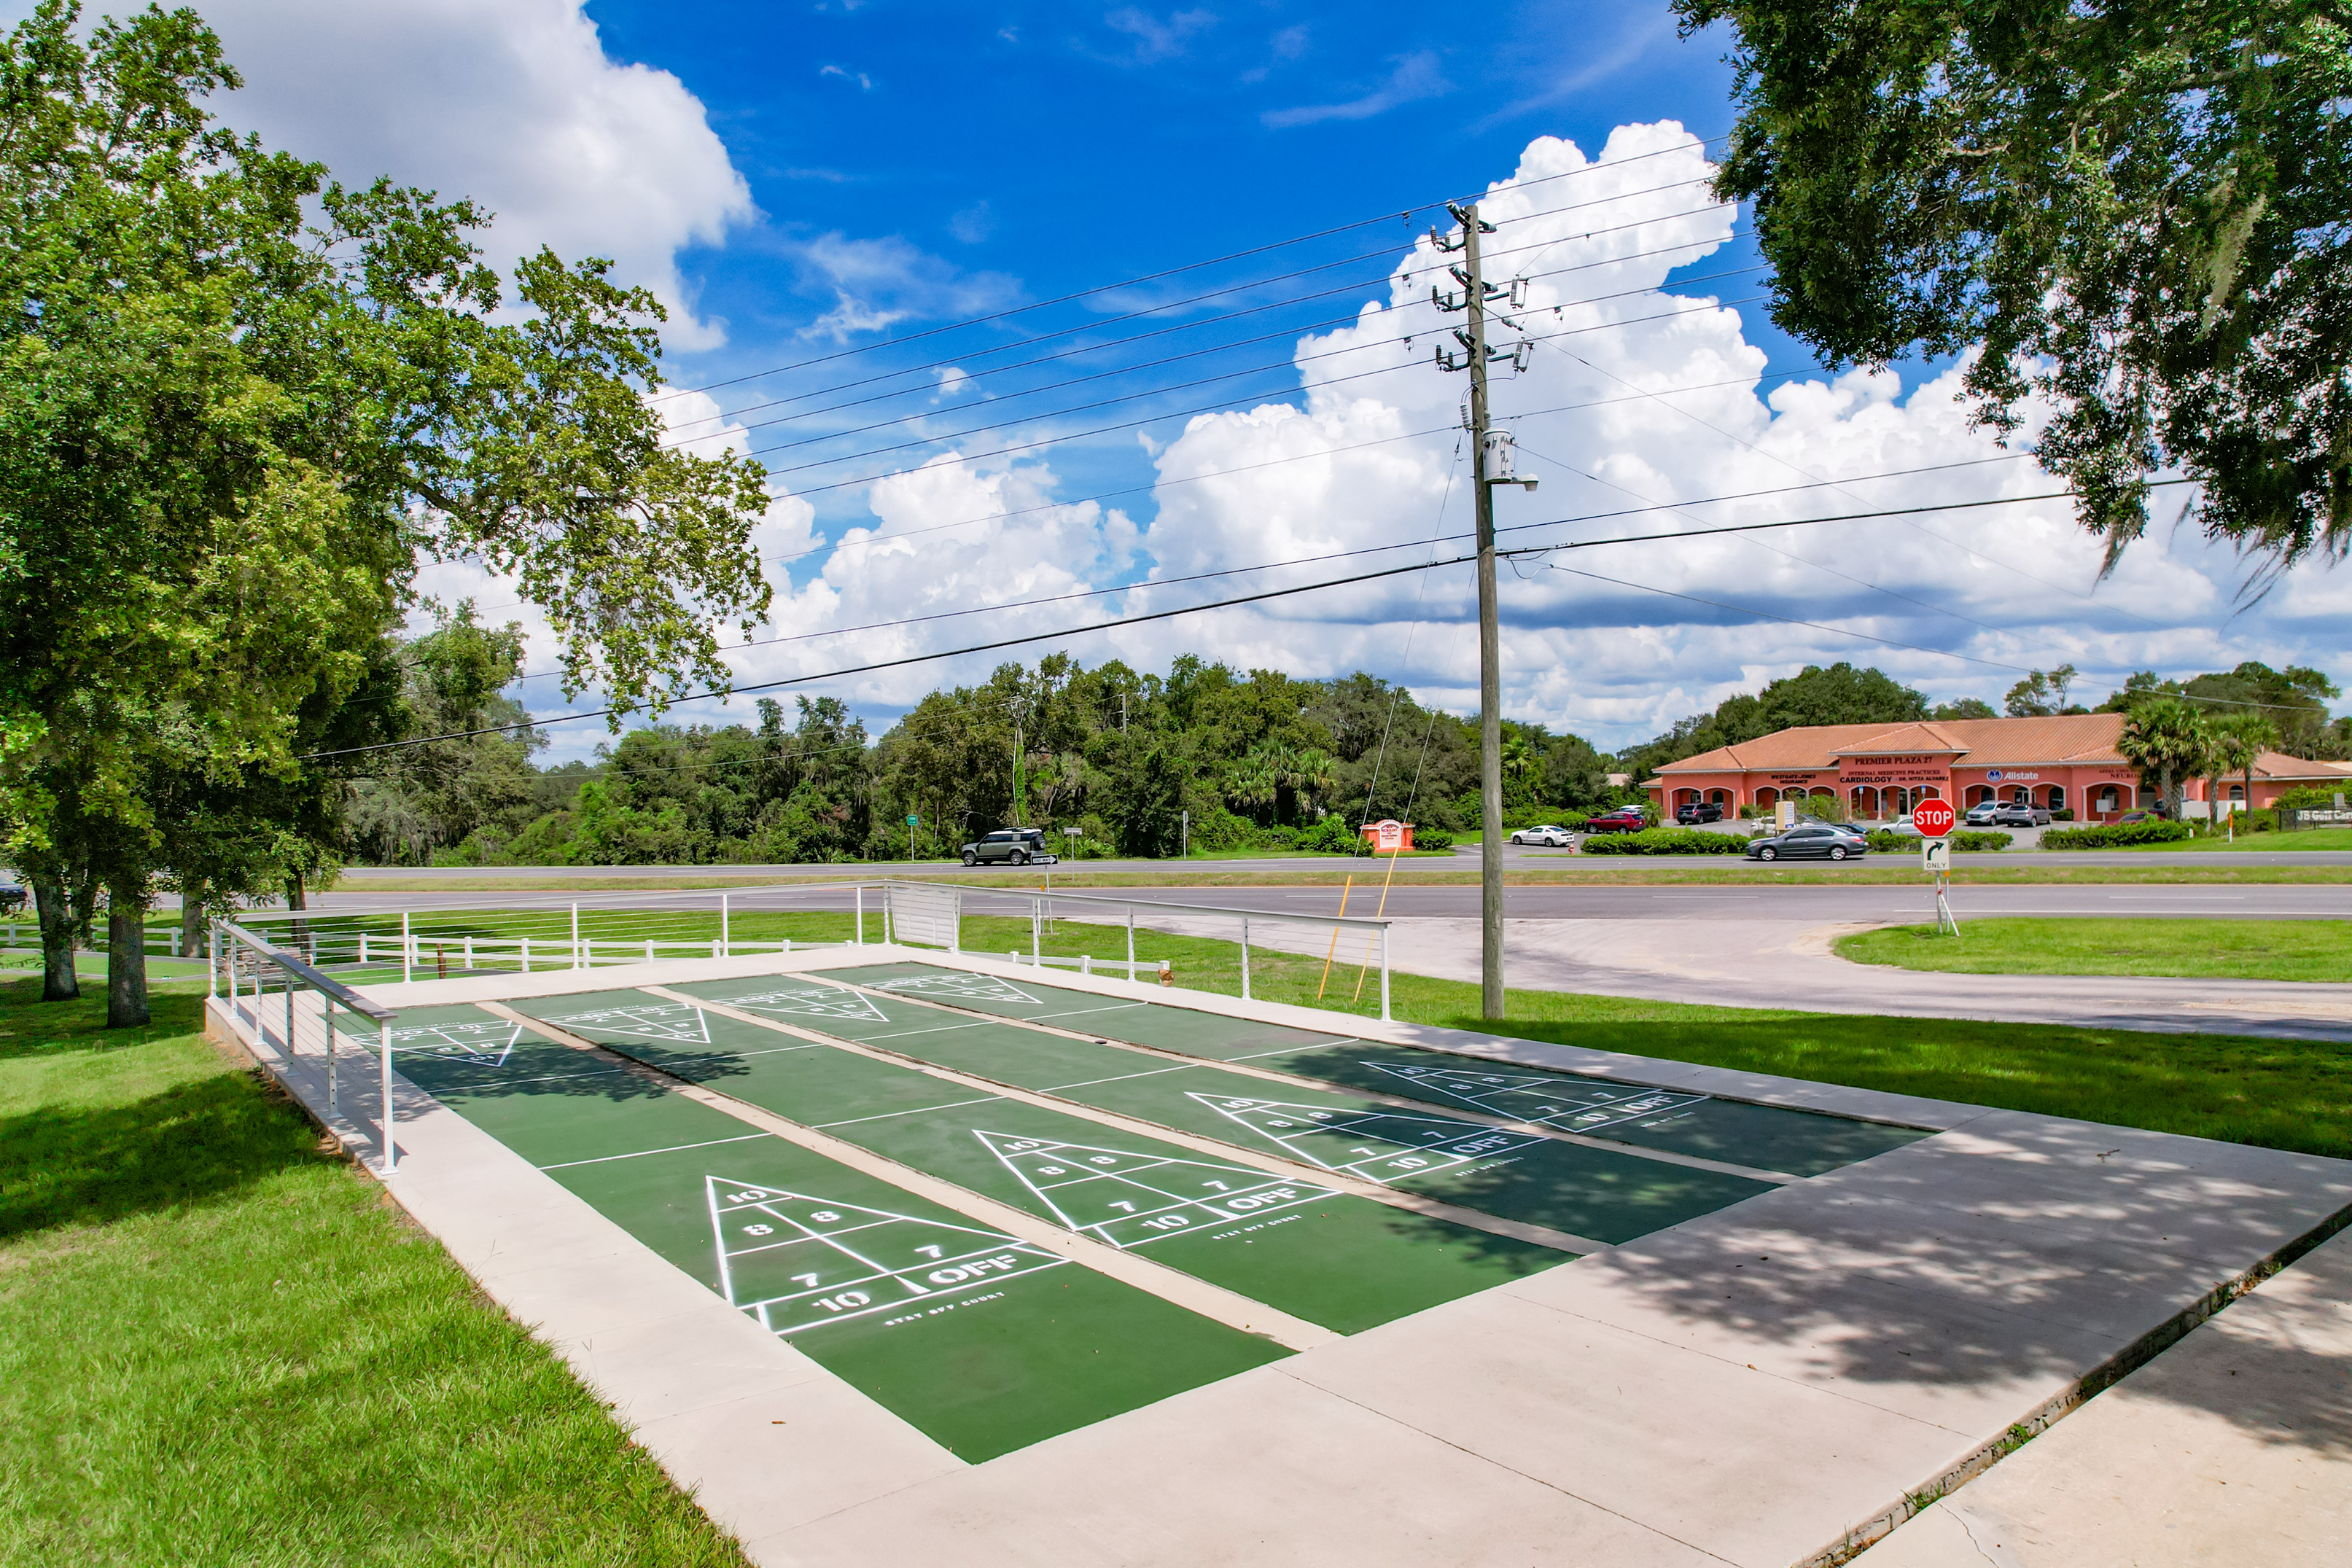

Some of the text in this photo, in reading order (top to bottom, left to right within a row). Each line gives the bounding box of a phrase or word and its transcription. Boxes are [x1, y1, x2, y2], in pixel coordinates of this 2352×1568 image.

[2004, 771, 2038, 780] Allstate
[1916, 811, 1952, 825] STOP
[2297, 810, 2310, 821] JB
[2311, 810, 2333, 821] Golf
[1220, 1099, 1253, 1108] 10
[1624, 1096, 1674, 1110] OFF
[1307, 1112, 1333, 1120] 8
[1003, 1140, 1040, 1150] 10
[1350, 1131, 1446, 1156] 7 7
[1387, 1136, 1509, 1169] 10 OFF
[1037, 1155, 1117, 1175] 8 8
[726, 1190, 767, 1203] 10
[1107, 1179, 1231, 1212] 7 7
[1140, 1187, 1296, 1230] 10 OFF
[743, 1211, 841, 1236] 8 8
[790, 1244, 942, 1287] 7 7
[811, 1254, 1017, 1312] 10 OFF
[884, 1291, 1005, 1326] STAY OFF COURT
